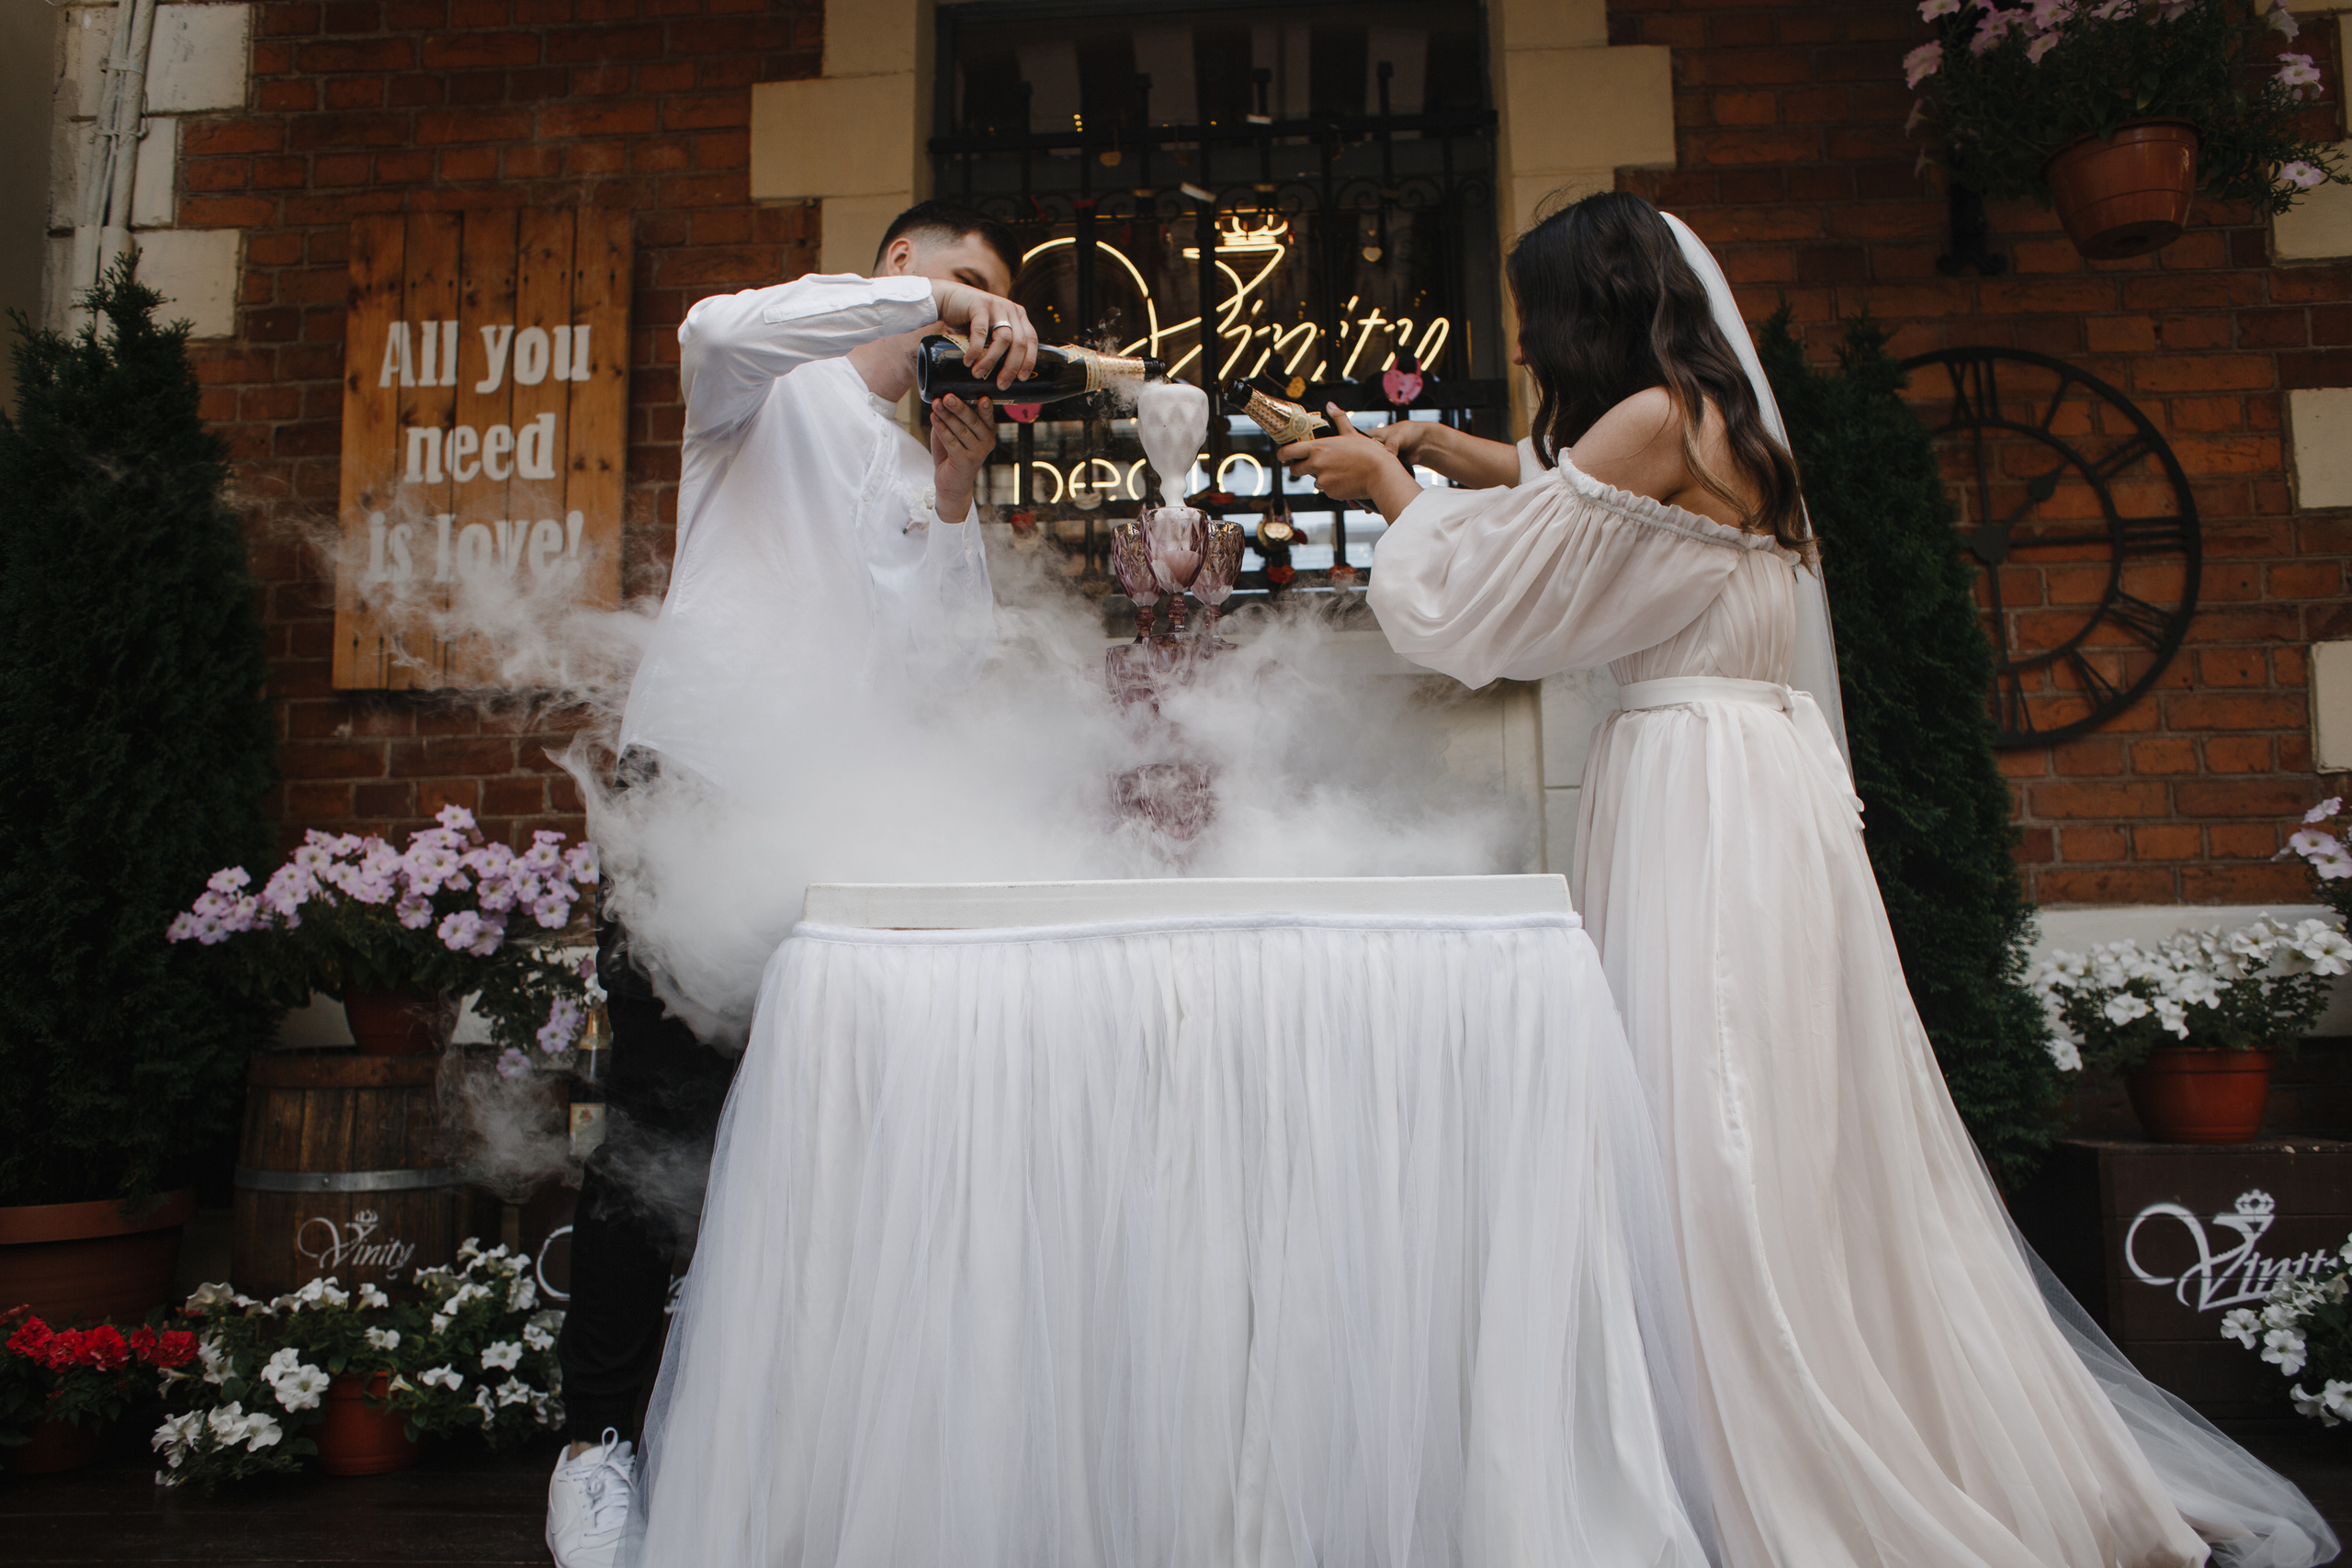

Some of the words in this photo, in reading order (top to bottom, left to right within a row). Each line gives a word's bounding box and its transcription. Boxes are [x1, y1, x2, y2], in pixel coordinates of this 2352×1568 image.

[379, 321, 458, 388] All
[475, 325, 592, 394] you
[403, 412, 556, 483] need
[366, 511, 414, 583] is
[433, 510, 584, 588] love!
[298, 1216, 416, 1280] Vinity
